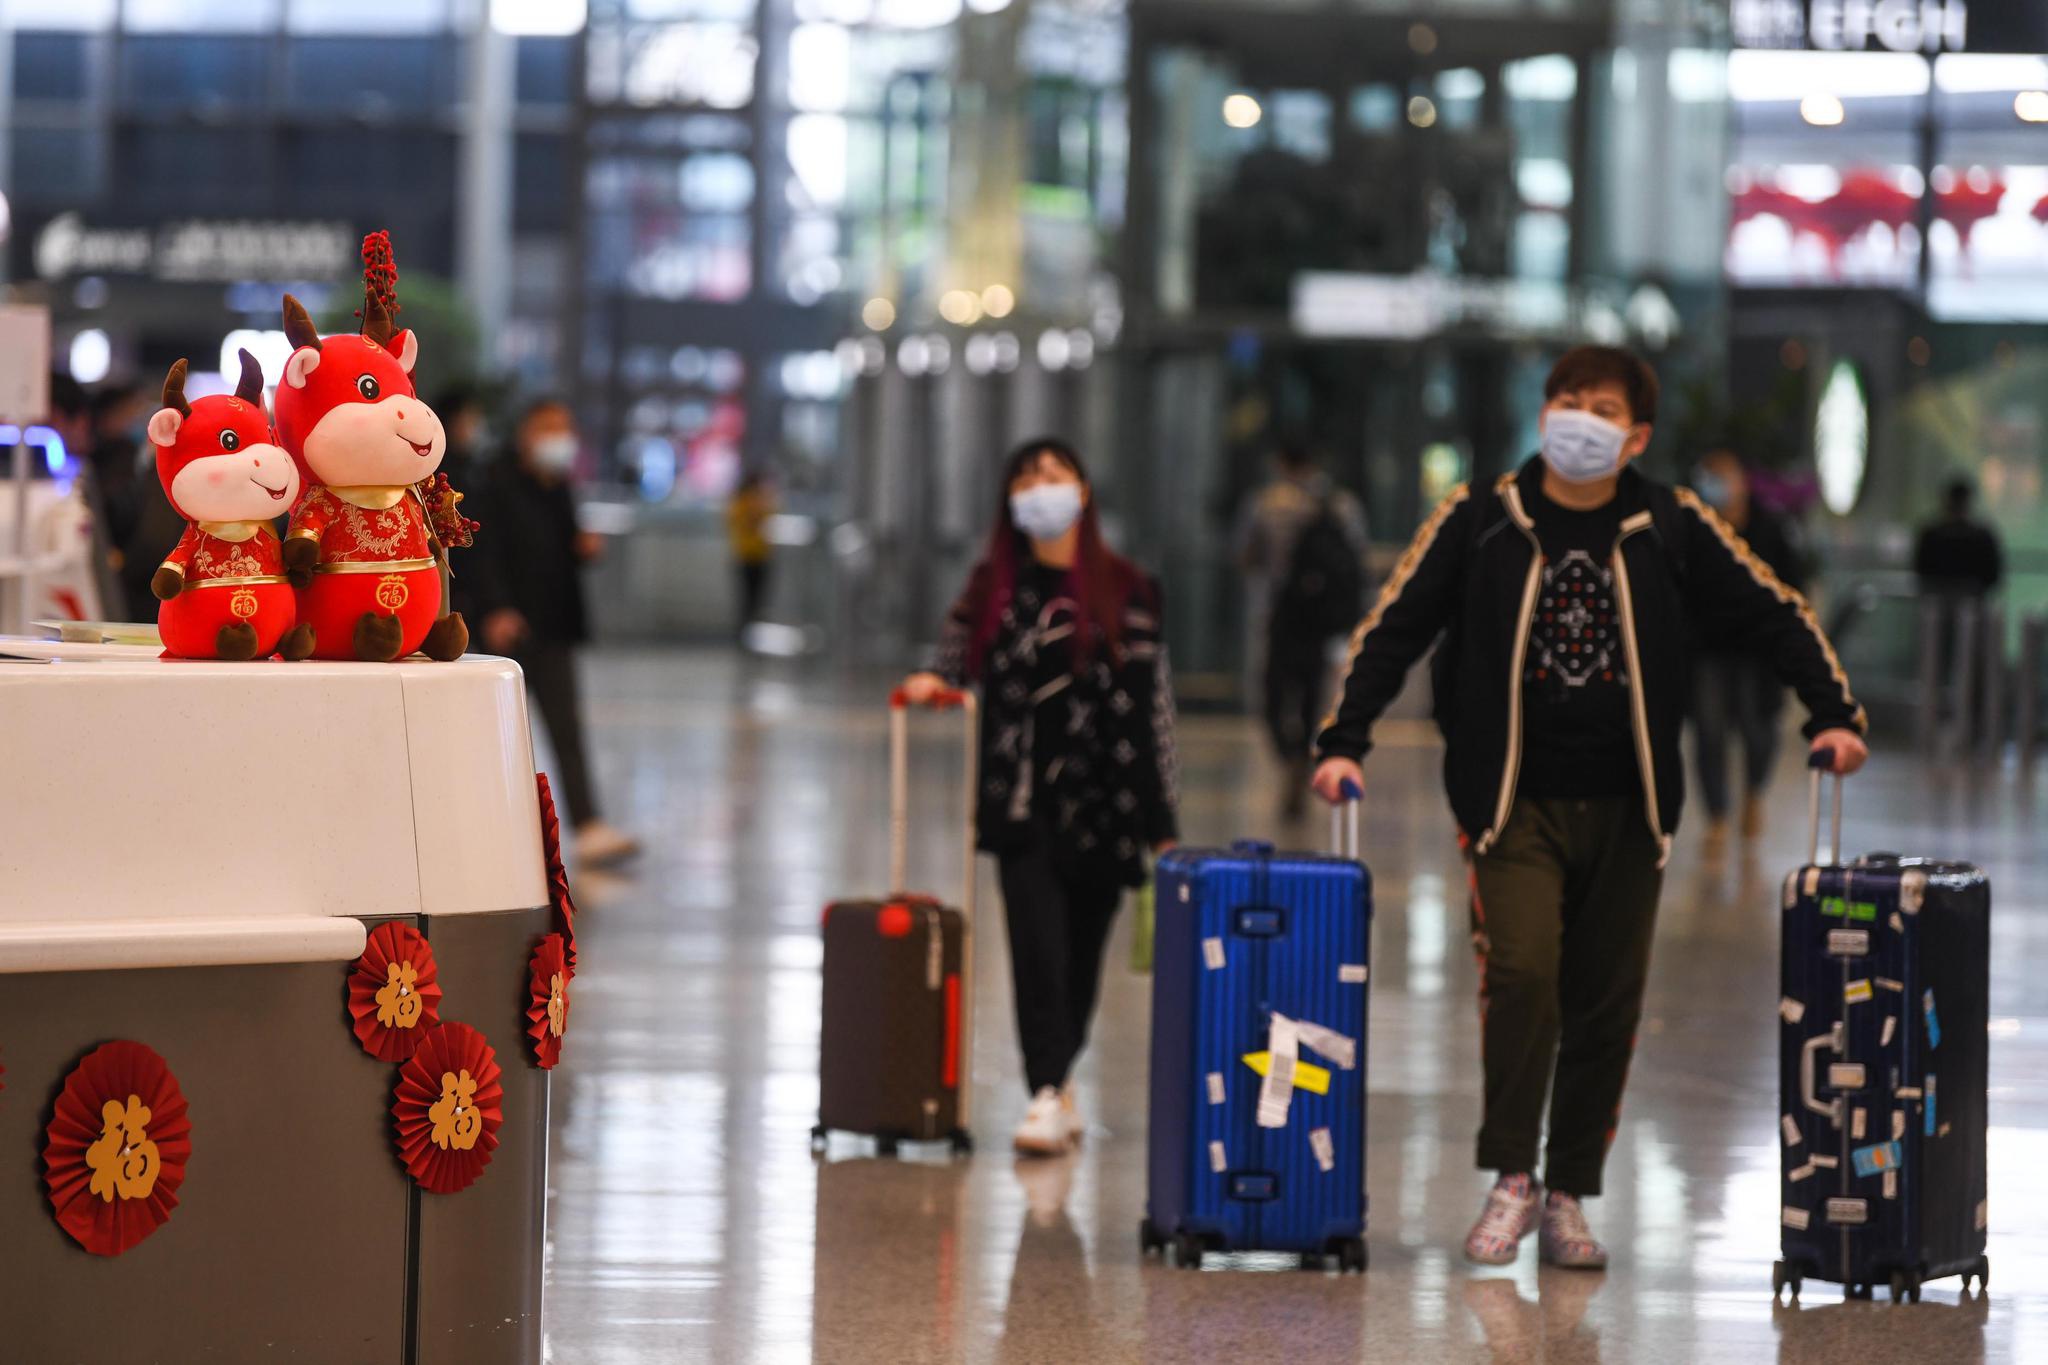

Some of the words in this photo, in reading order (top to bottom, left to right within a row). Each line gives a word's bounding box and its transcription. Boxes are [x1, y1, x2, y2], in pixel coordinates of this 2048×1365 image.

[1808, 0, 1966, 51] EFGH
[381, 585, 402, 605] 福
[375, 960, 422, 1028] 福
[547, 971, 564, 1038] 福
[428, 1069, 481, 1150] 福
[85, 1094, 160, 1203] 福
